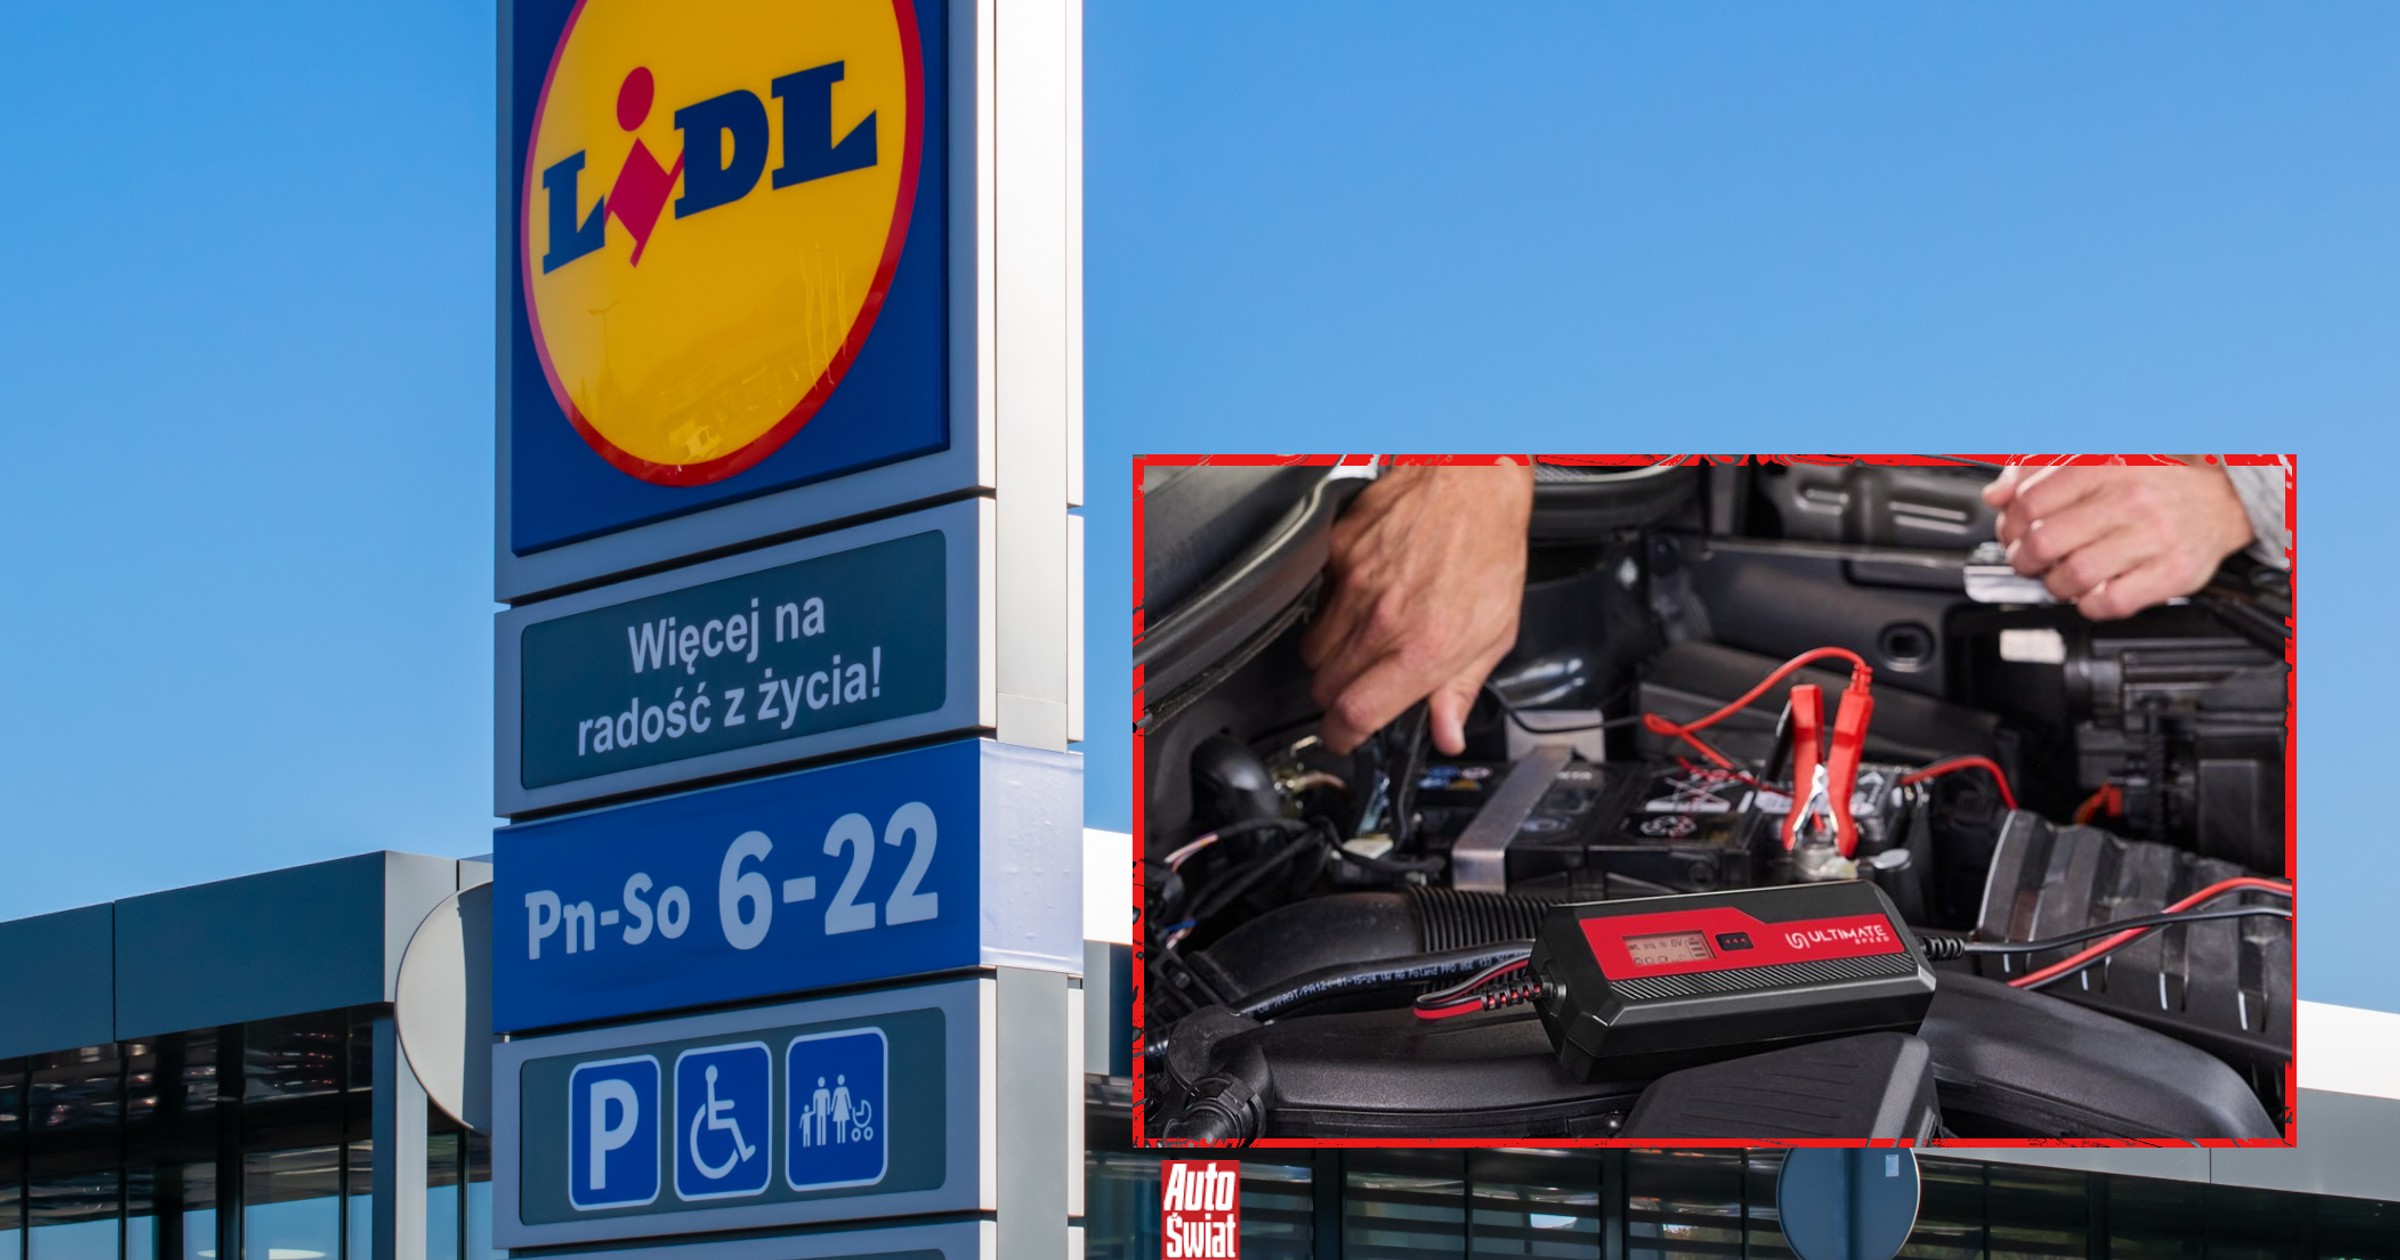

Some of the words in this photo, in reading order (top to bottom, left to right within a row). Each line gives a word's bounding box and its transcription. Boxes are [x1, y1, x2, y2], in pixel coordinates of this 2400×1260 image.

[627, 597, 760, 675] Więcej
[775, 596, 826, 642] na
[578, 680, 711, 756] radość
[723, 687, 746, 727] z
[757, 645, 882, 729] życia!
[524, 872, 691, 960] Pn-So
[718, 801, 939, 950] 6-22
[1807, 924, 1887, 943] ULTIMATE
[589, 1079, 639, 1190] P
